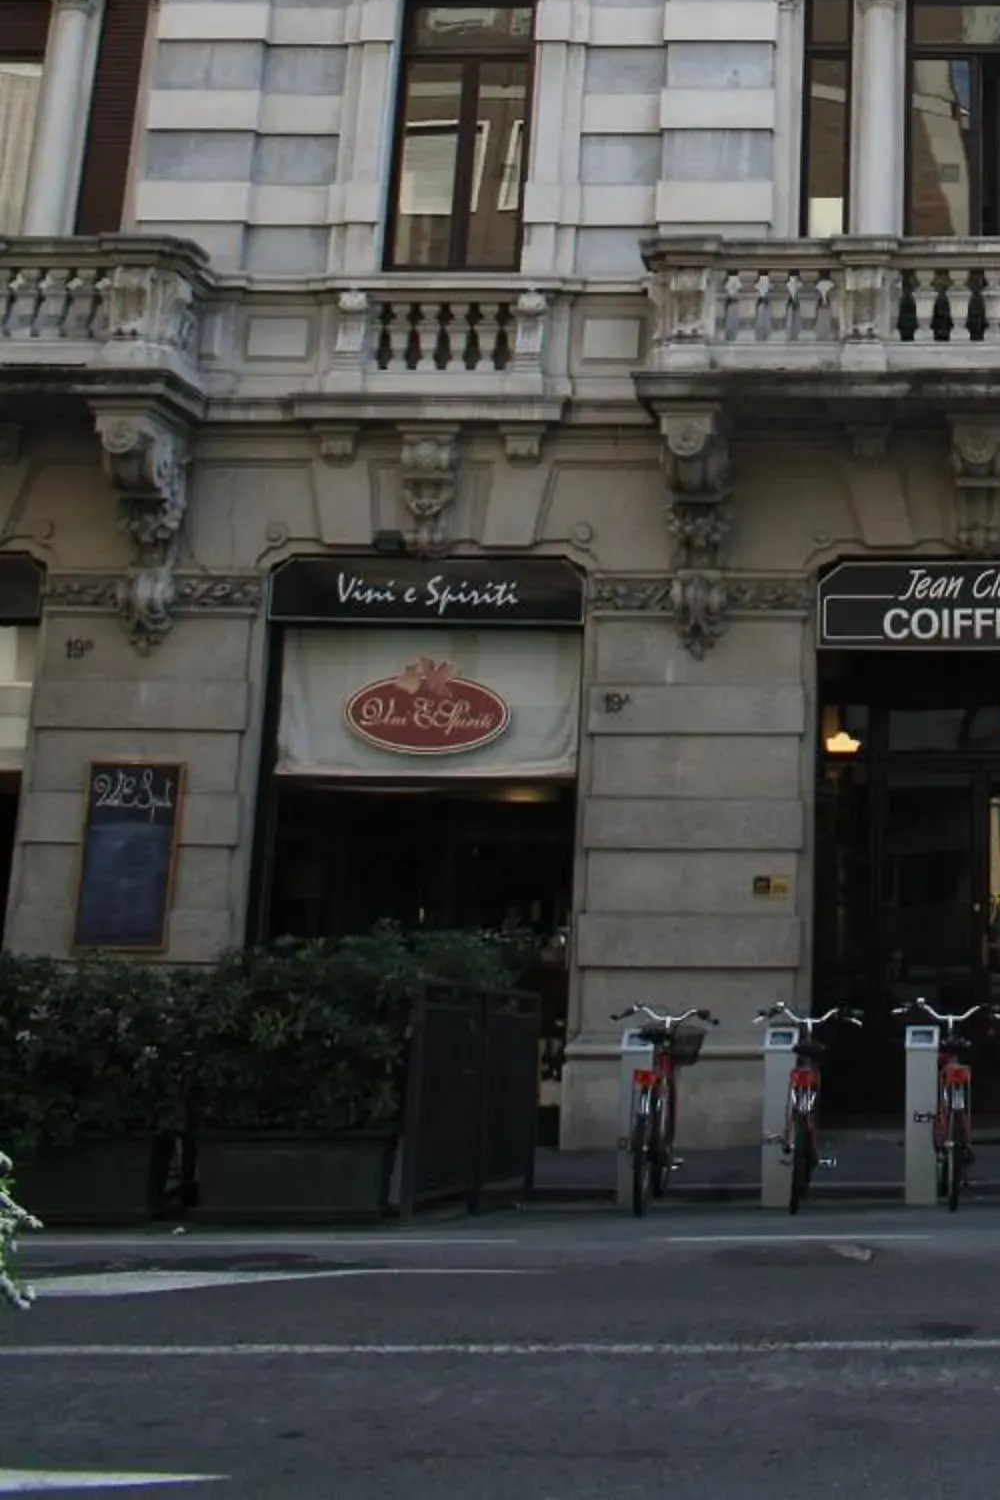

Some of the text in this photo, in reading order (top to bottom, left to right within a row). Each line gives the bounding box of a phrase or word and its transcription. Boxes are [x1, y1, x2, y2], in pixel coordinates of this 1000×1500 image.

[337, 572, 519, 615] Vini e Spiriti
[898, 569, 964, 600] Jean
